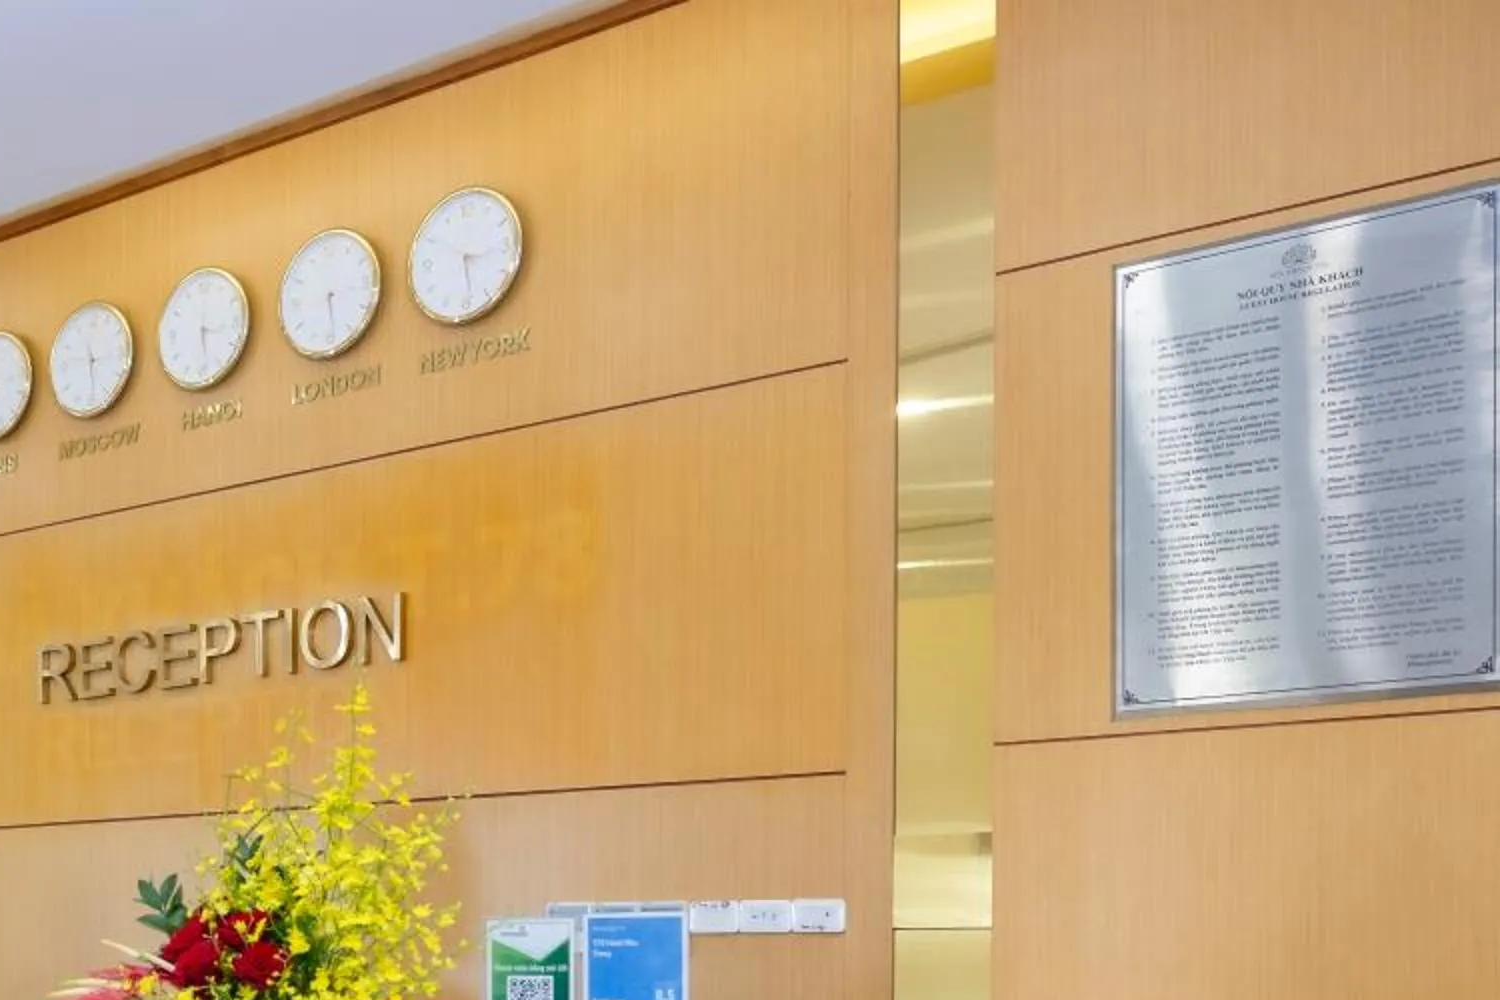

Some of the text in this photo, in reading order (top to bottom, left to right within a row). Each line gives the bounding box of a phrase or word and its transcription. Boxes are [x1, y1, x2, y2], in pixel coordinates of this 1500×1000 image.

[291, 363, 382, 405] LONDON
[182, 399, 244, 431] HANOI
[59, 422, 142, 461] MOSCOW
[36, 590, 408, 705] RECEPTION
